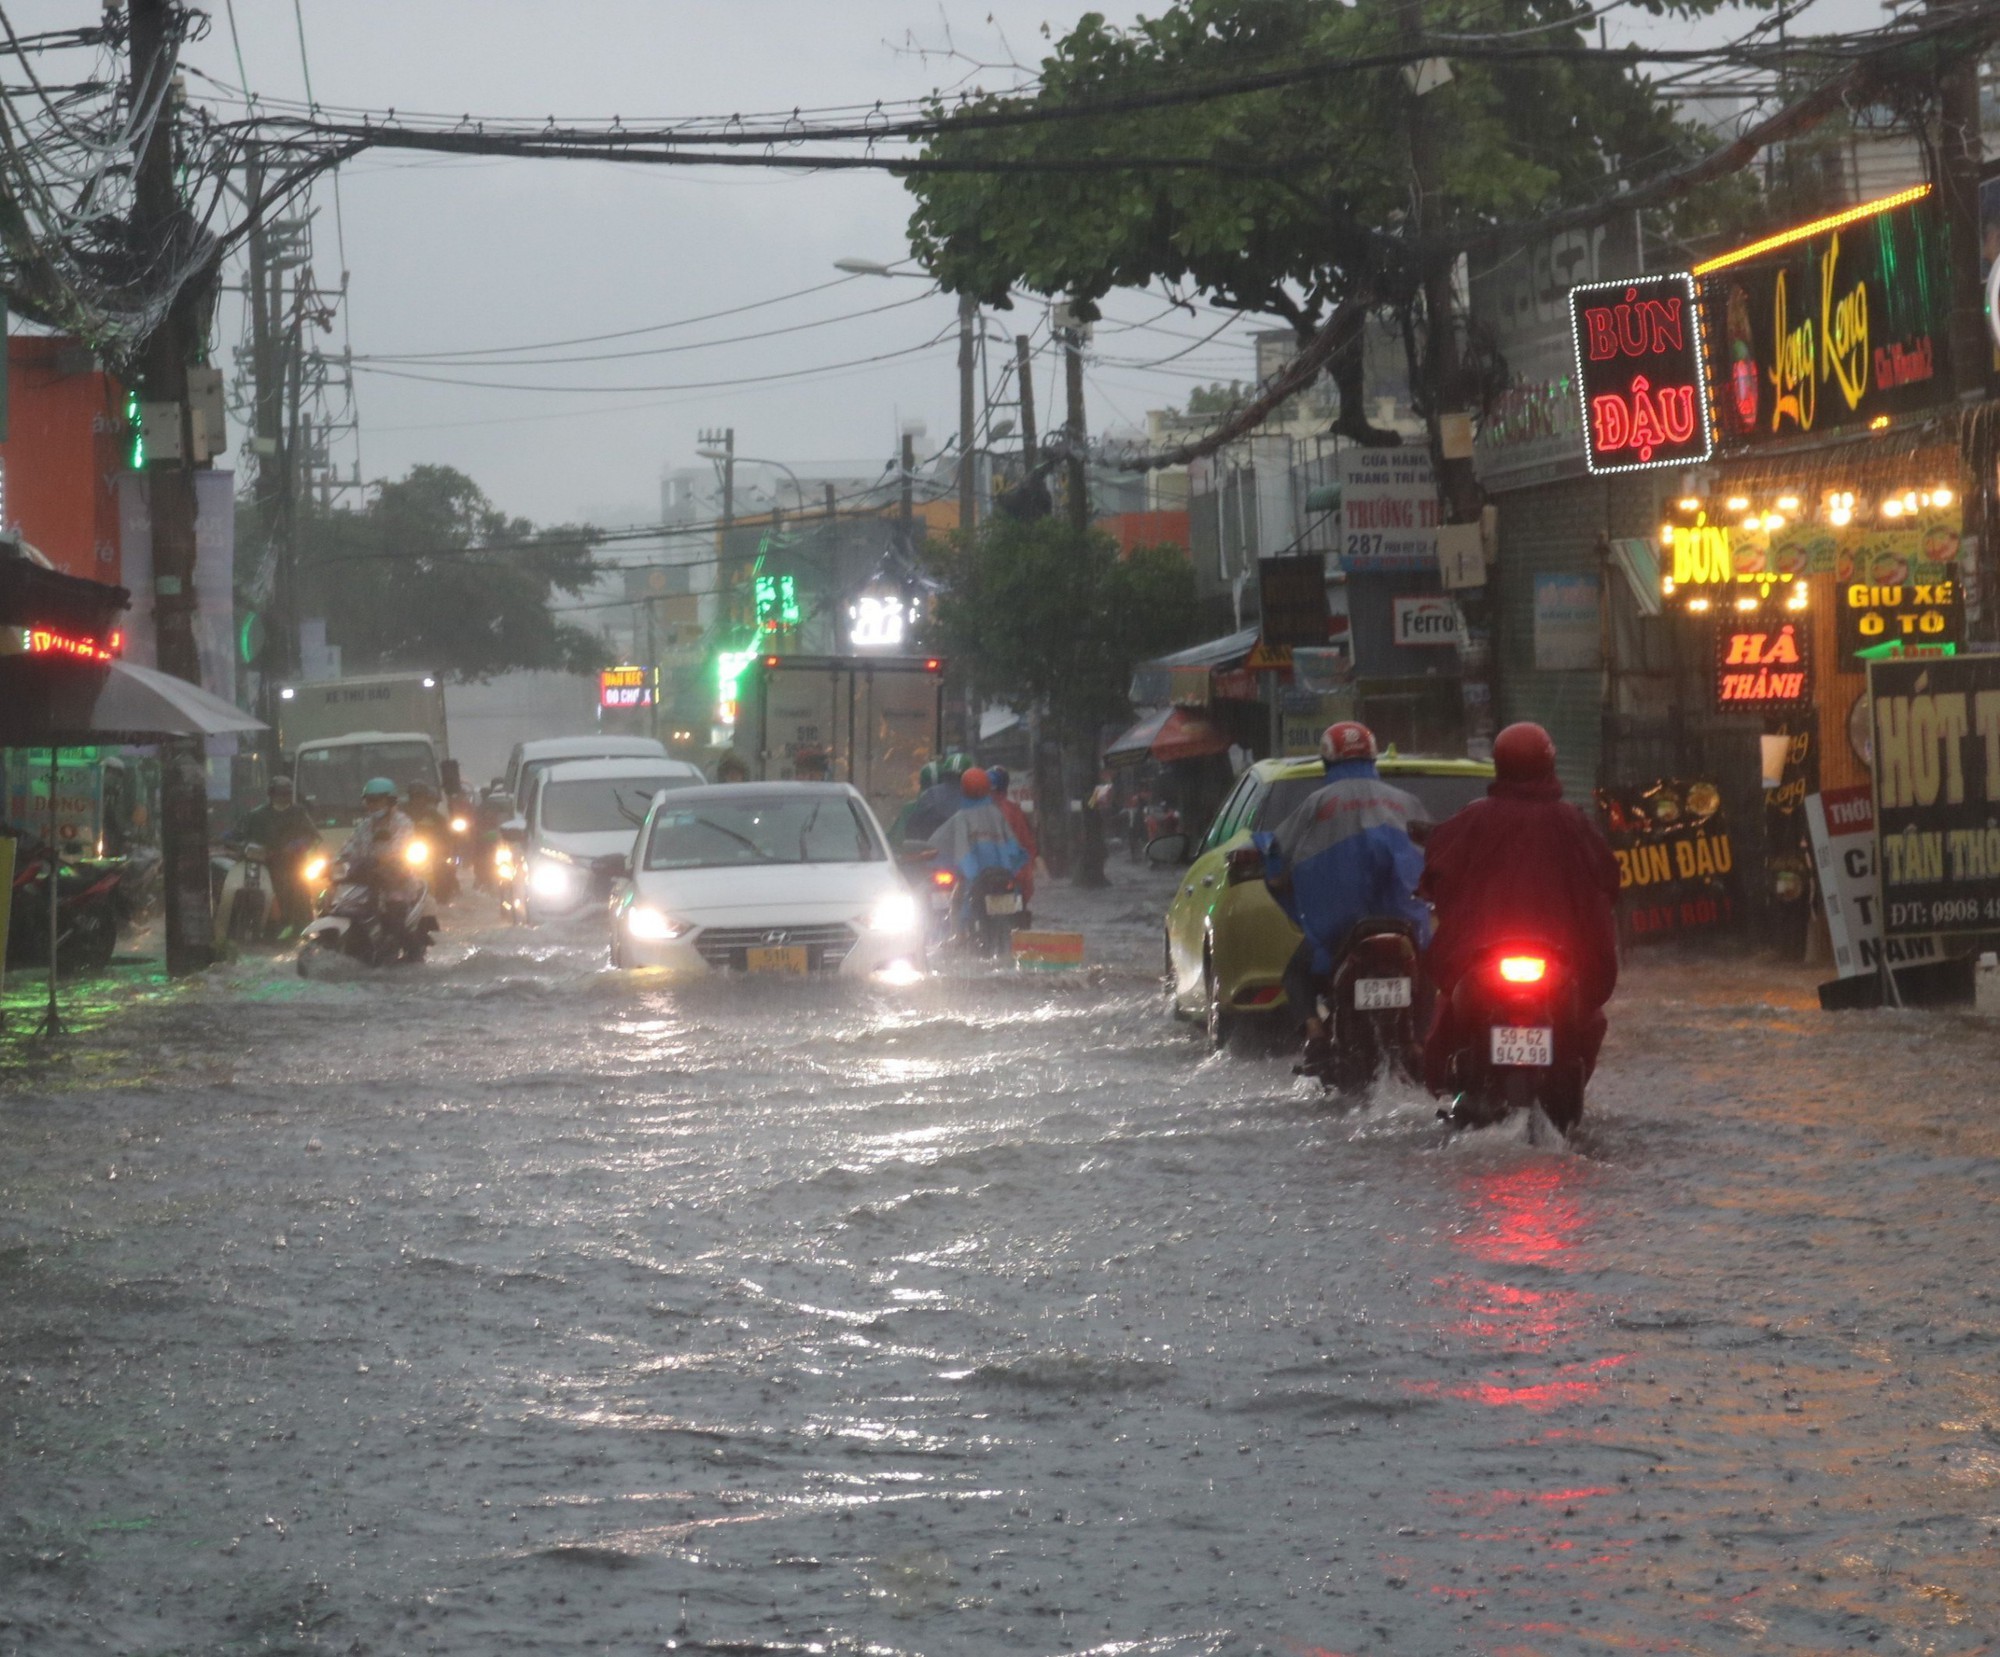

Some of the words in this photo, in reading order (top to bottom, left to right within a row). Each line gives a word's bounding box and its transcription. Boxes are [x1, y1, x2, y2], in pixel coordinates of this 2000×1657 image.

[1585, 288, 1683, 360] BÚN
[1593, 374, 1695, 462] ĐẬU
[1347, 534, 1382, 555] 287
[1673, 510, 1730, 583] BÚN
[1402, 610, 1459, 638] Ferro
[1859, 612, 1884, 635] Ô
[1897, 610, 1944, 634] TÔ
[1613, 839, 1672, 888] BÚN
[1675, 828, 1732, 885] ĐẬU
[1884, 823, 1944, 886] TÂN
[1890, 902, 1927, 927] ĐT:
[1931, 899, 1979, 925] 0908
[1859, 936, 1936, 968] NAM
[1500, 1030, 1544, 1046] 59-G2
[1496, 1046, 1547, 1064] 942.98
